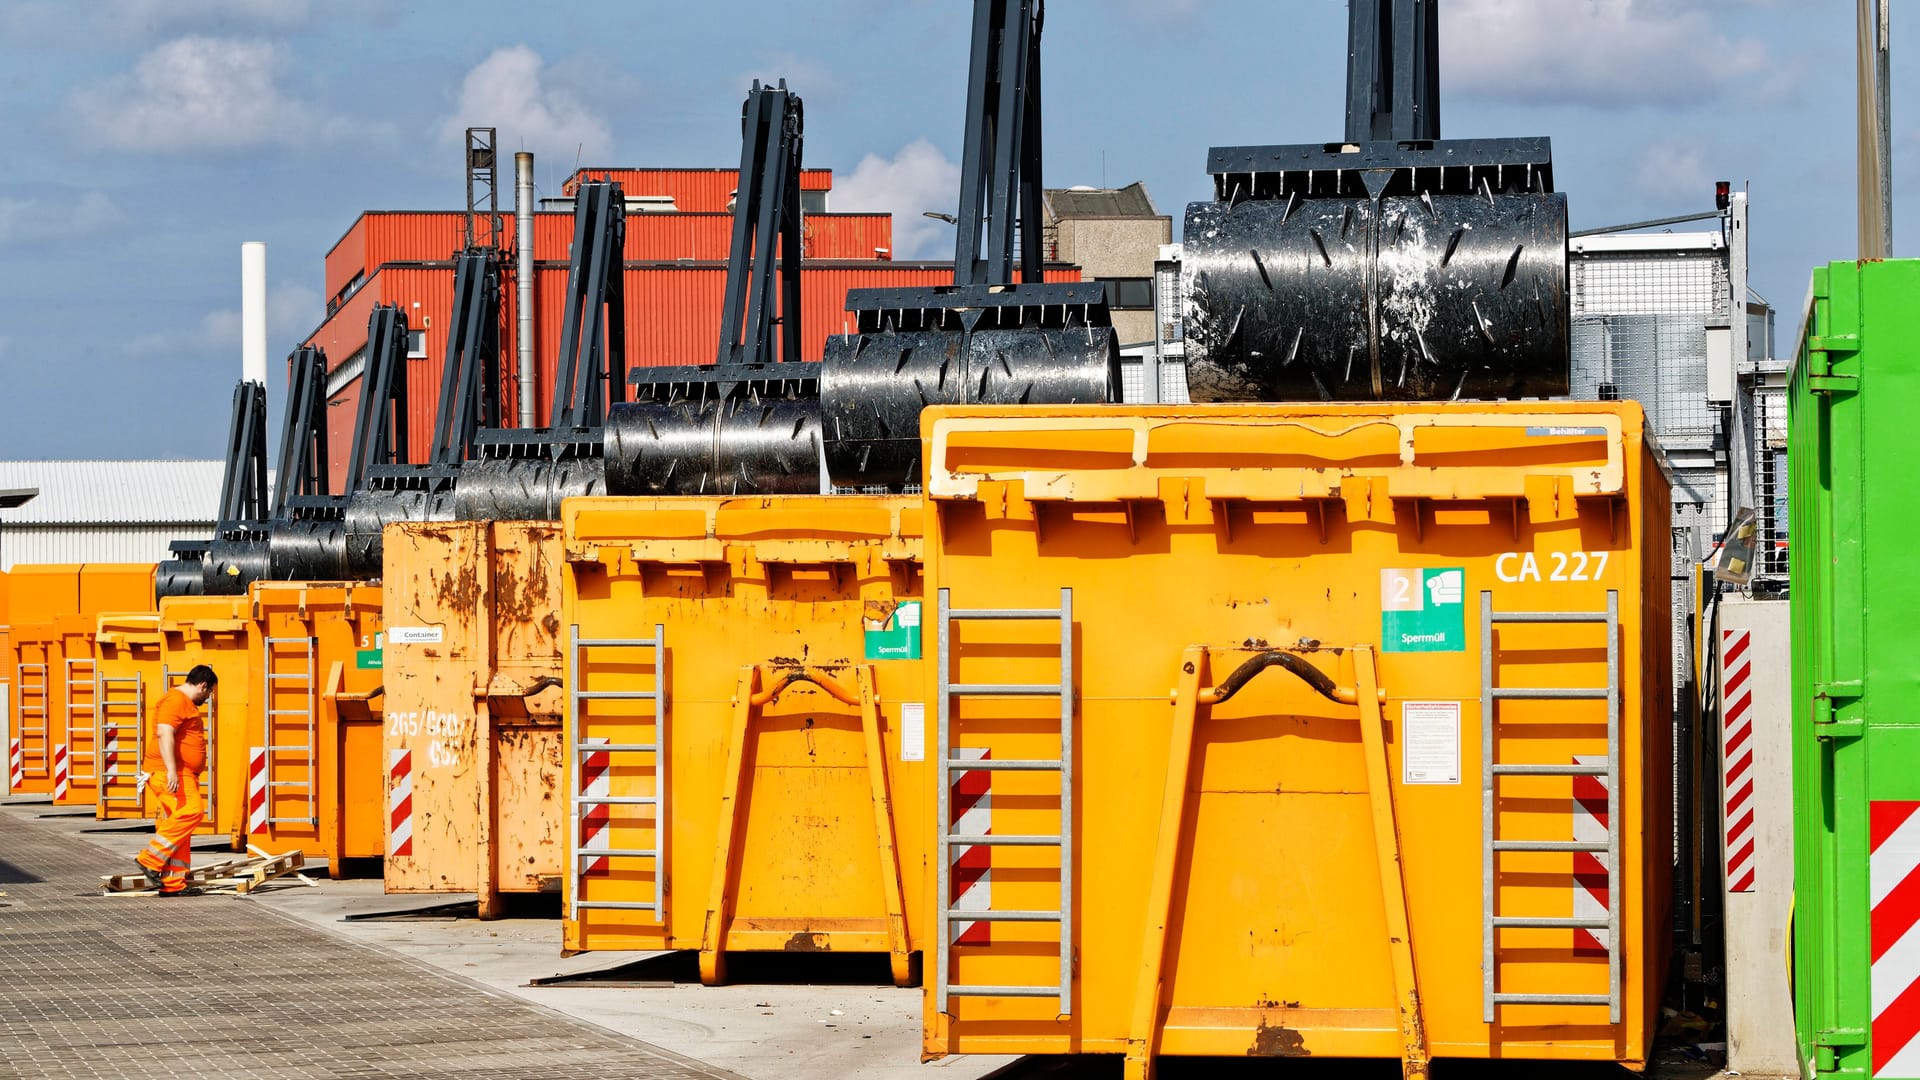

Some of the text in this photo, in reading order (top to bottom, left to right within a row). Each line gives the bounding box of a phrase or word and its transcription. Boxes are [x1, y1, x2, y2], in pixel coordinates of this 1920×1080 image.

[1495, 551, 1609, 582] CA 227
[1391, 576, 1410, 602] 2
[361, 635, 369, 648] 5
[1401, 632, 1446, 645] Sperrmüll
